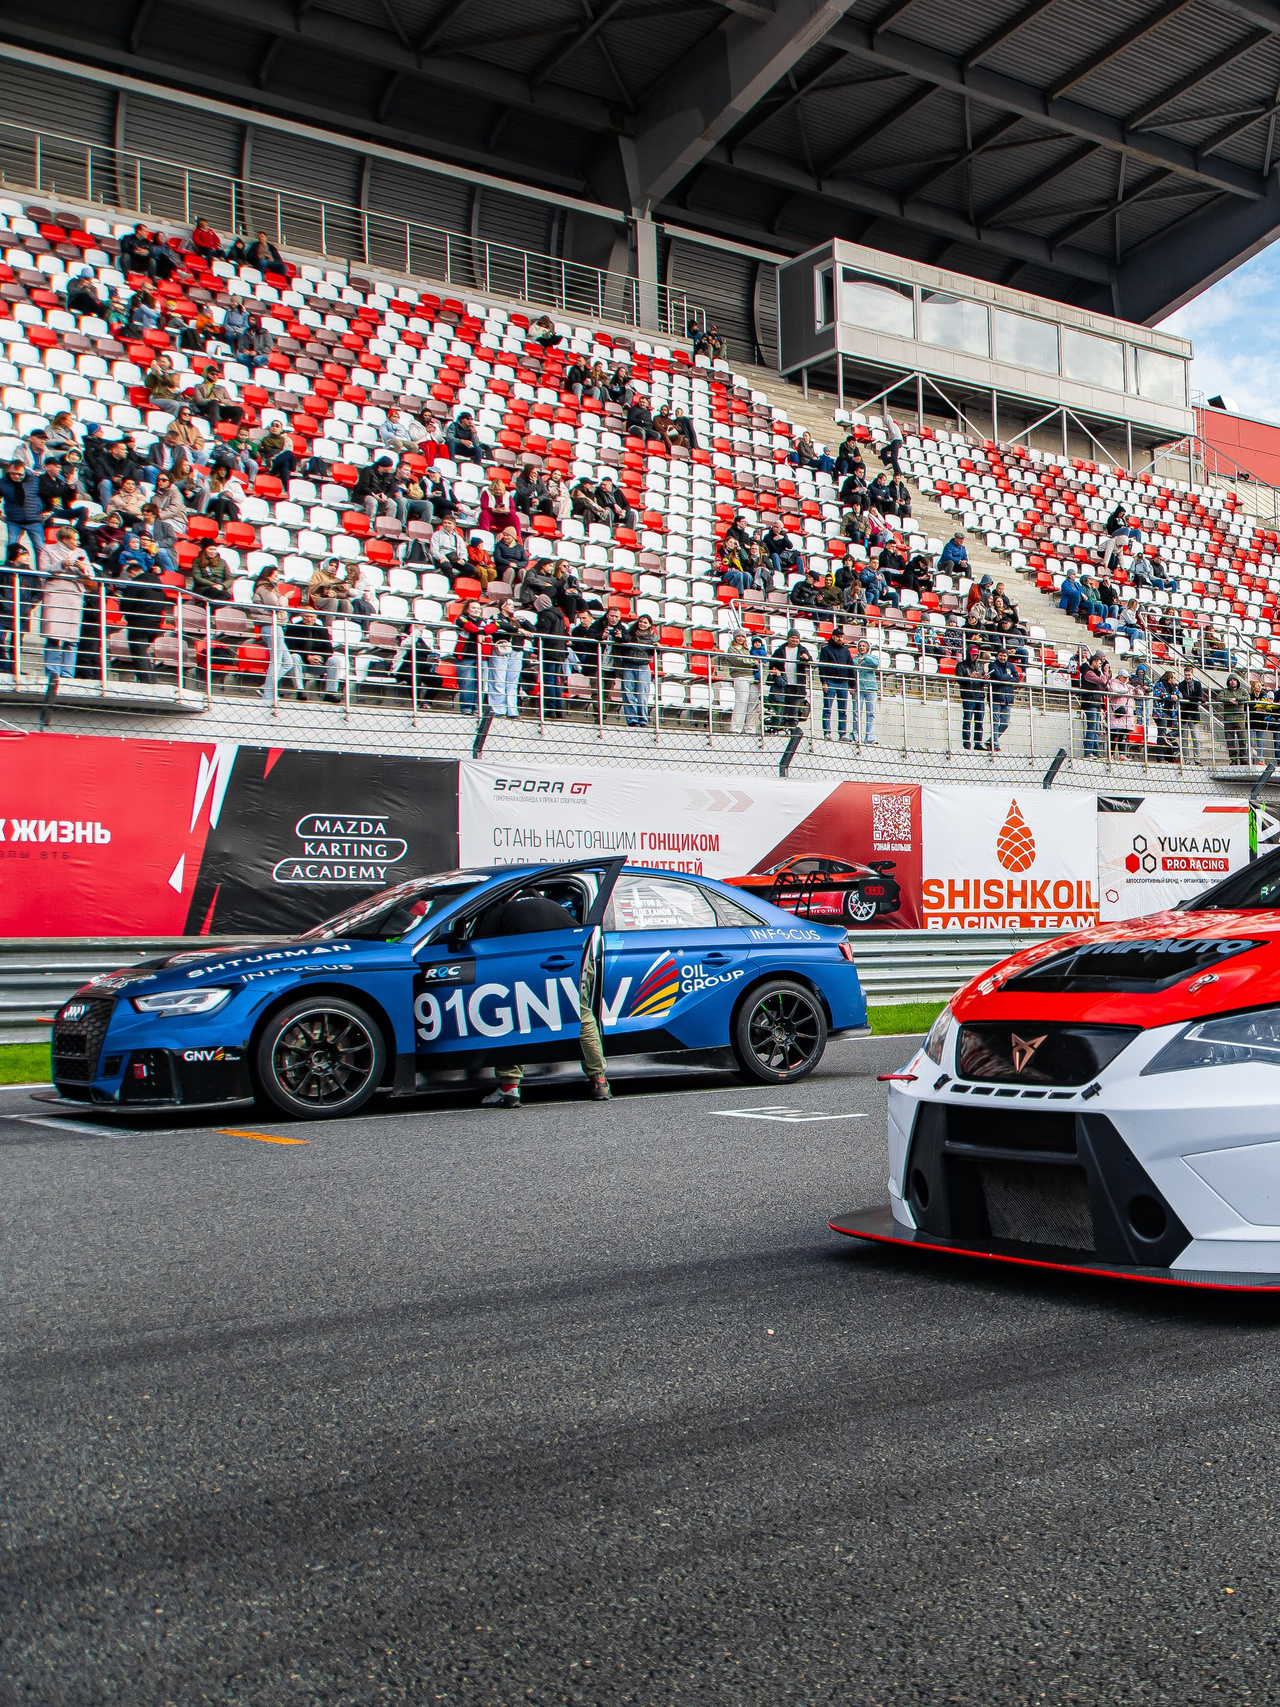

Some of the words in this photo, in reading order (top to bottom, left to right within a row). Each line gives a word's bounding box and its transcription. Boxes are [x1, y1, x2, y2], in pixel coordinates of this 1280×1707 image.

[494, 778, 565, 794] SPORA
[570, 782, 592, 795] GT
[11, 819, 111, 844] ЖИЗНЬ
[314, 819, 387, 835] MAZDA
[493, 827, 542, 848] СТАНЬ
[546, 829, 637, 851] НАСТОЯЩИМ
[640, 832, 720, 853] ГОНЩИКОМ
[873, 842, 890, 851] УЗНАЙ
[891, 843, 912, 852] БОЛЬШЕ
[1157, 836, 1199, 853] YUKA
[1202, 838, 1230, 853] ADV
[303, 842, 387, 857] KARTING
[291, 864, 388, 879] ACADEMY
[1167, 859, 1187, 869] PRO
[1190, 860, 1225, 870] RACING
[922, 879, 1099, 910] SHISHKOIL
[927, 916, 1021, 929] RACING
[1030, 916, 1095, 929] TEAM
[1075, 939, 1252, 955] VMPAUTO
[187, 944, 351, 979] SHTURMAN
[681, 964, 707, 979] OIL
[681, 969, 745, 994] GROUP
[414, 988, 468, 1041] 91
[183, 1050, 216, 1062] GNV
